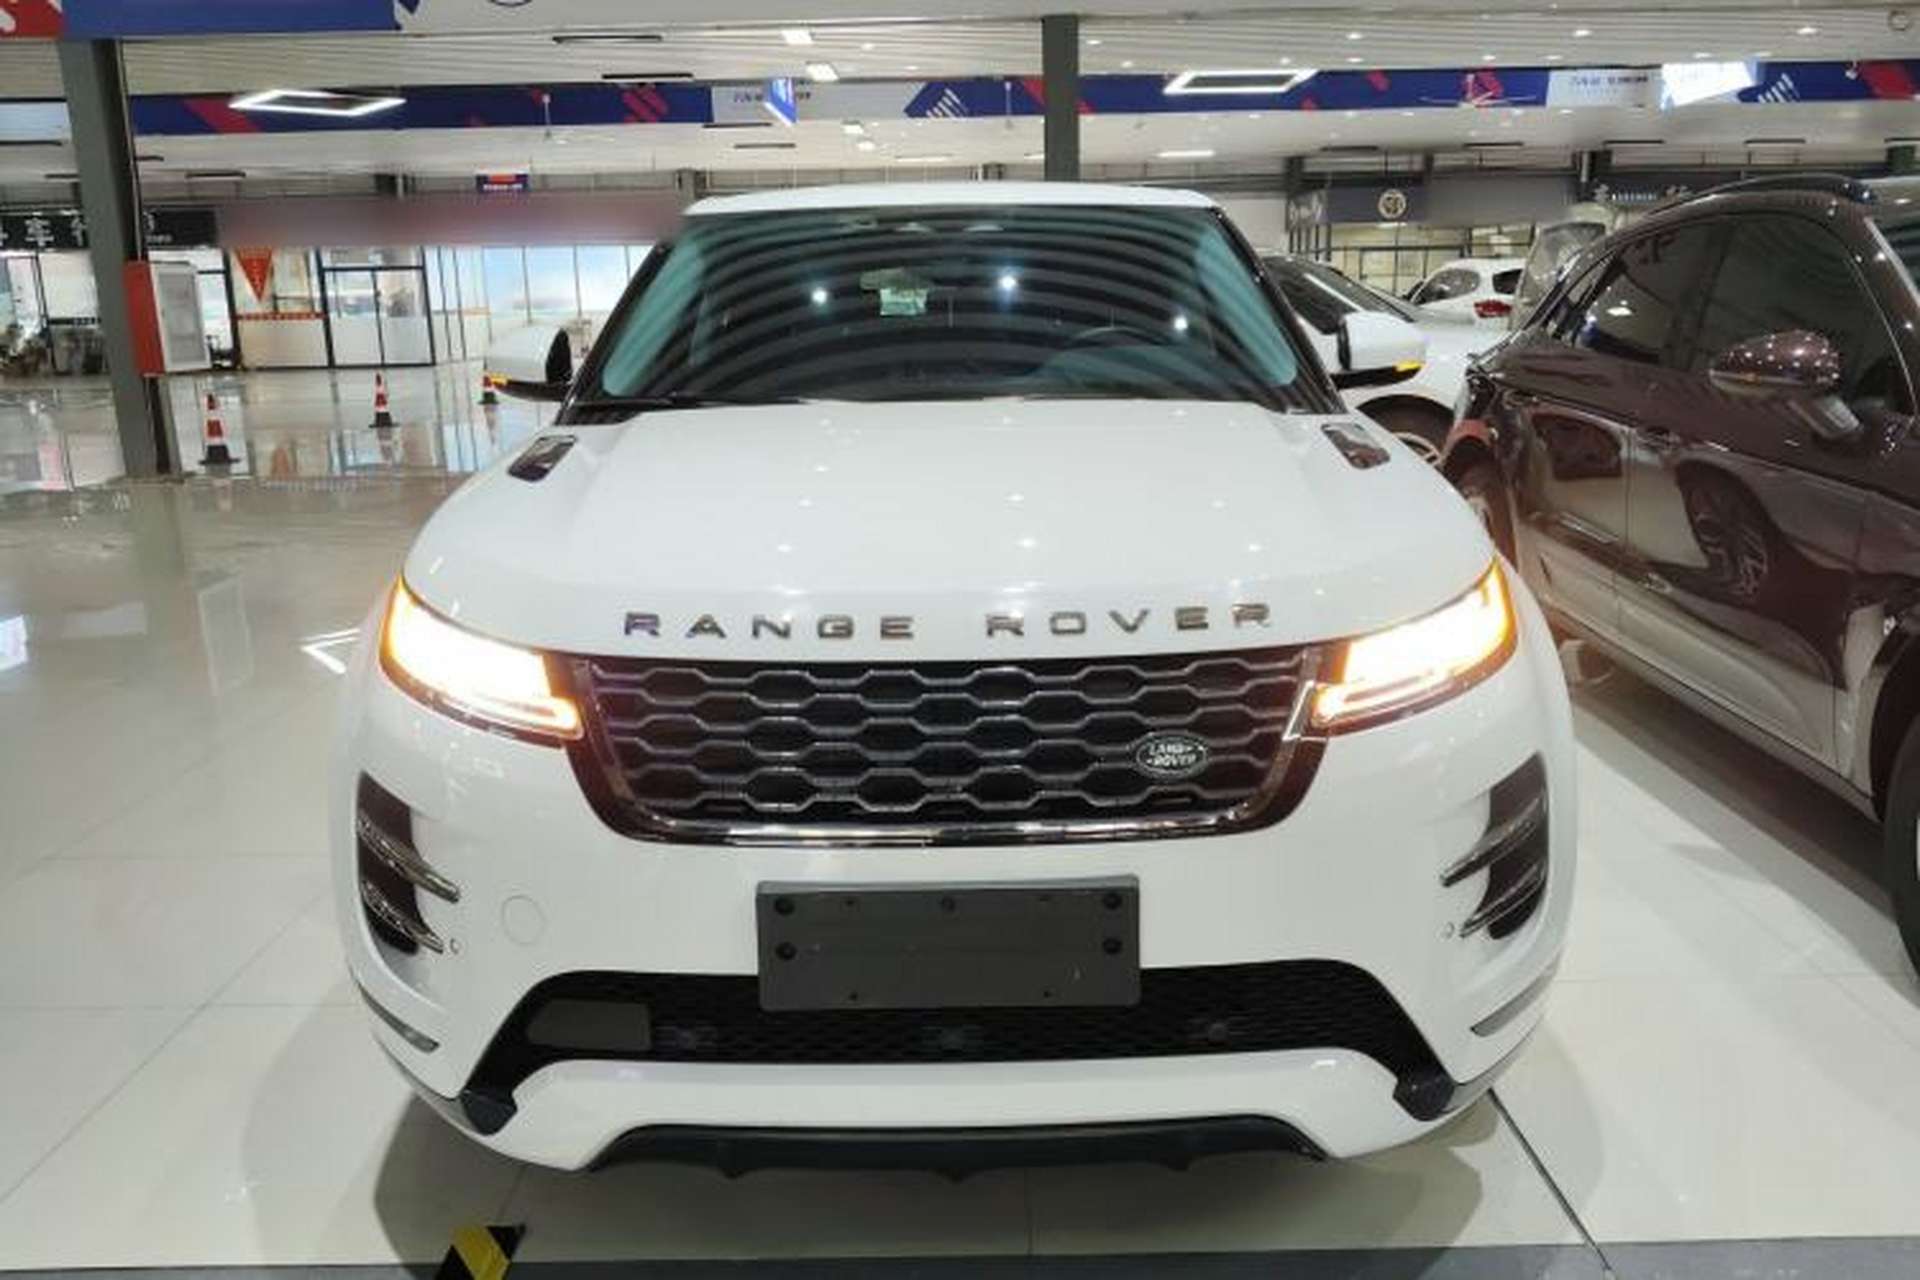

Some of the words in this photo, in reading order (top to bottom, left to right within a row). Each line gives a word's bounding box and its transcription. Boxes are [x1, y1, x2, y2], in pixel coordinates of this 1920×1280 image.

[624, 611, 914, 640] RANGE
[985, 602, 1272, 638] ROVER
[1148, 742, 1184, 755] LAND
